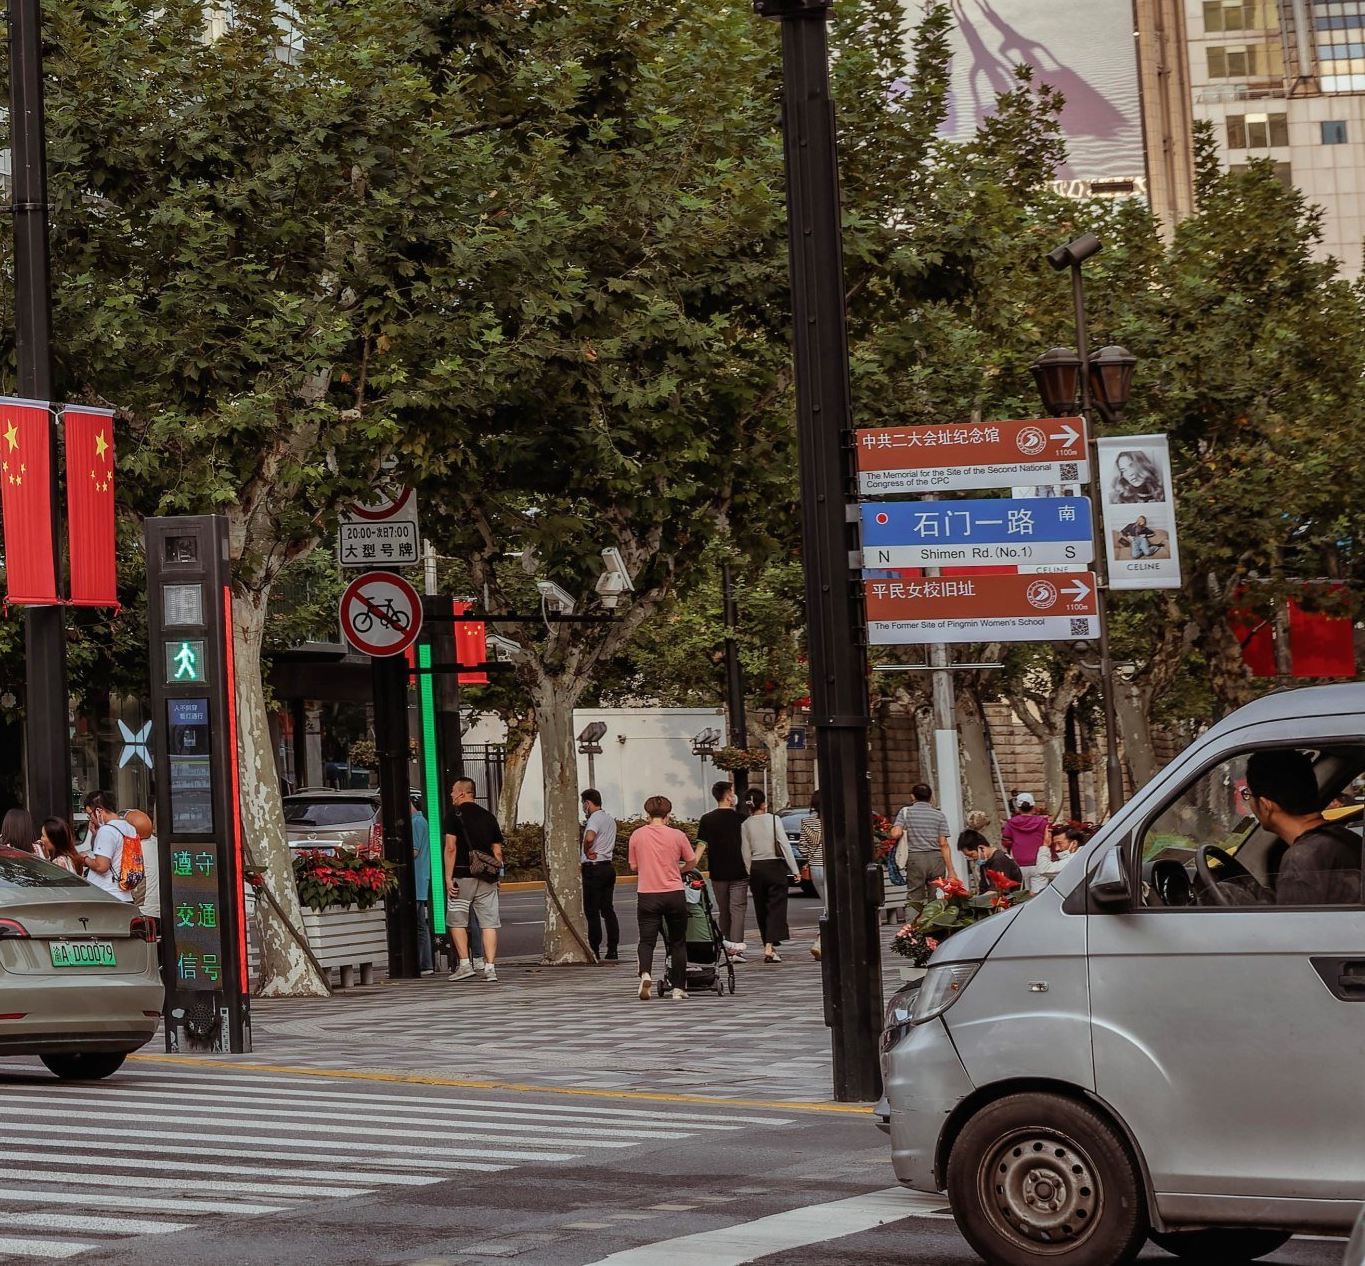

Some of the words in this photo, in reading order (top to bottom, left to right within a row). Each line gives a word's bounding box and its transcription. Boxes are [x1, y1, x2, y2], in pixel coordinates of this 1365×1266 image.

[862, 427, 1000, 450] 中共二大会址纪念馆
[1054, 448, 1078, 457] 1100m
[866, 472, 881, 480] The
[883, 470, 918, 479] Memorial
[946, 468, 961, 476] Site
[963, 467, 971, 475] of
[972, 466, 986, 475] the
[987, 465, 1017, 474] Second
[1020, 463, 1052, 472] National
[866, 480, 904, 489] Congress
[906, 478, 915, 486] of
[916, 478, 929, 486] the
[930, 476, 950, 485] CPC
[913, 508, 1035, 537] 石门一路
[1058, 505, 1076, 522] 南
[345, 542, 413, 558] 大型号牌
[878, 550, 890, 563] N
[920, 548, 966, 560] Shimen
[1065, 545, 1076, 559] S
[1127, 563, 1161, 571] CELINE
[871, 581, 976, 600] 平民女校旧址
[875, 622, 889, 630] The
[921, 621, 936, 629] Site
[938, 620, 946, 628] of
[947, 619, 978, 629] Pingmin
[980, 619, 1015, 627] Women's
[1018, 618, 1045, 626] School
[173, 850, 214, 876] 遵守
[176, 902, 217, 928] 交通
[177, 952, 222, 981] 信号
